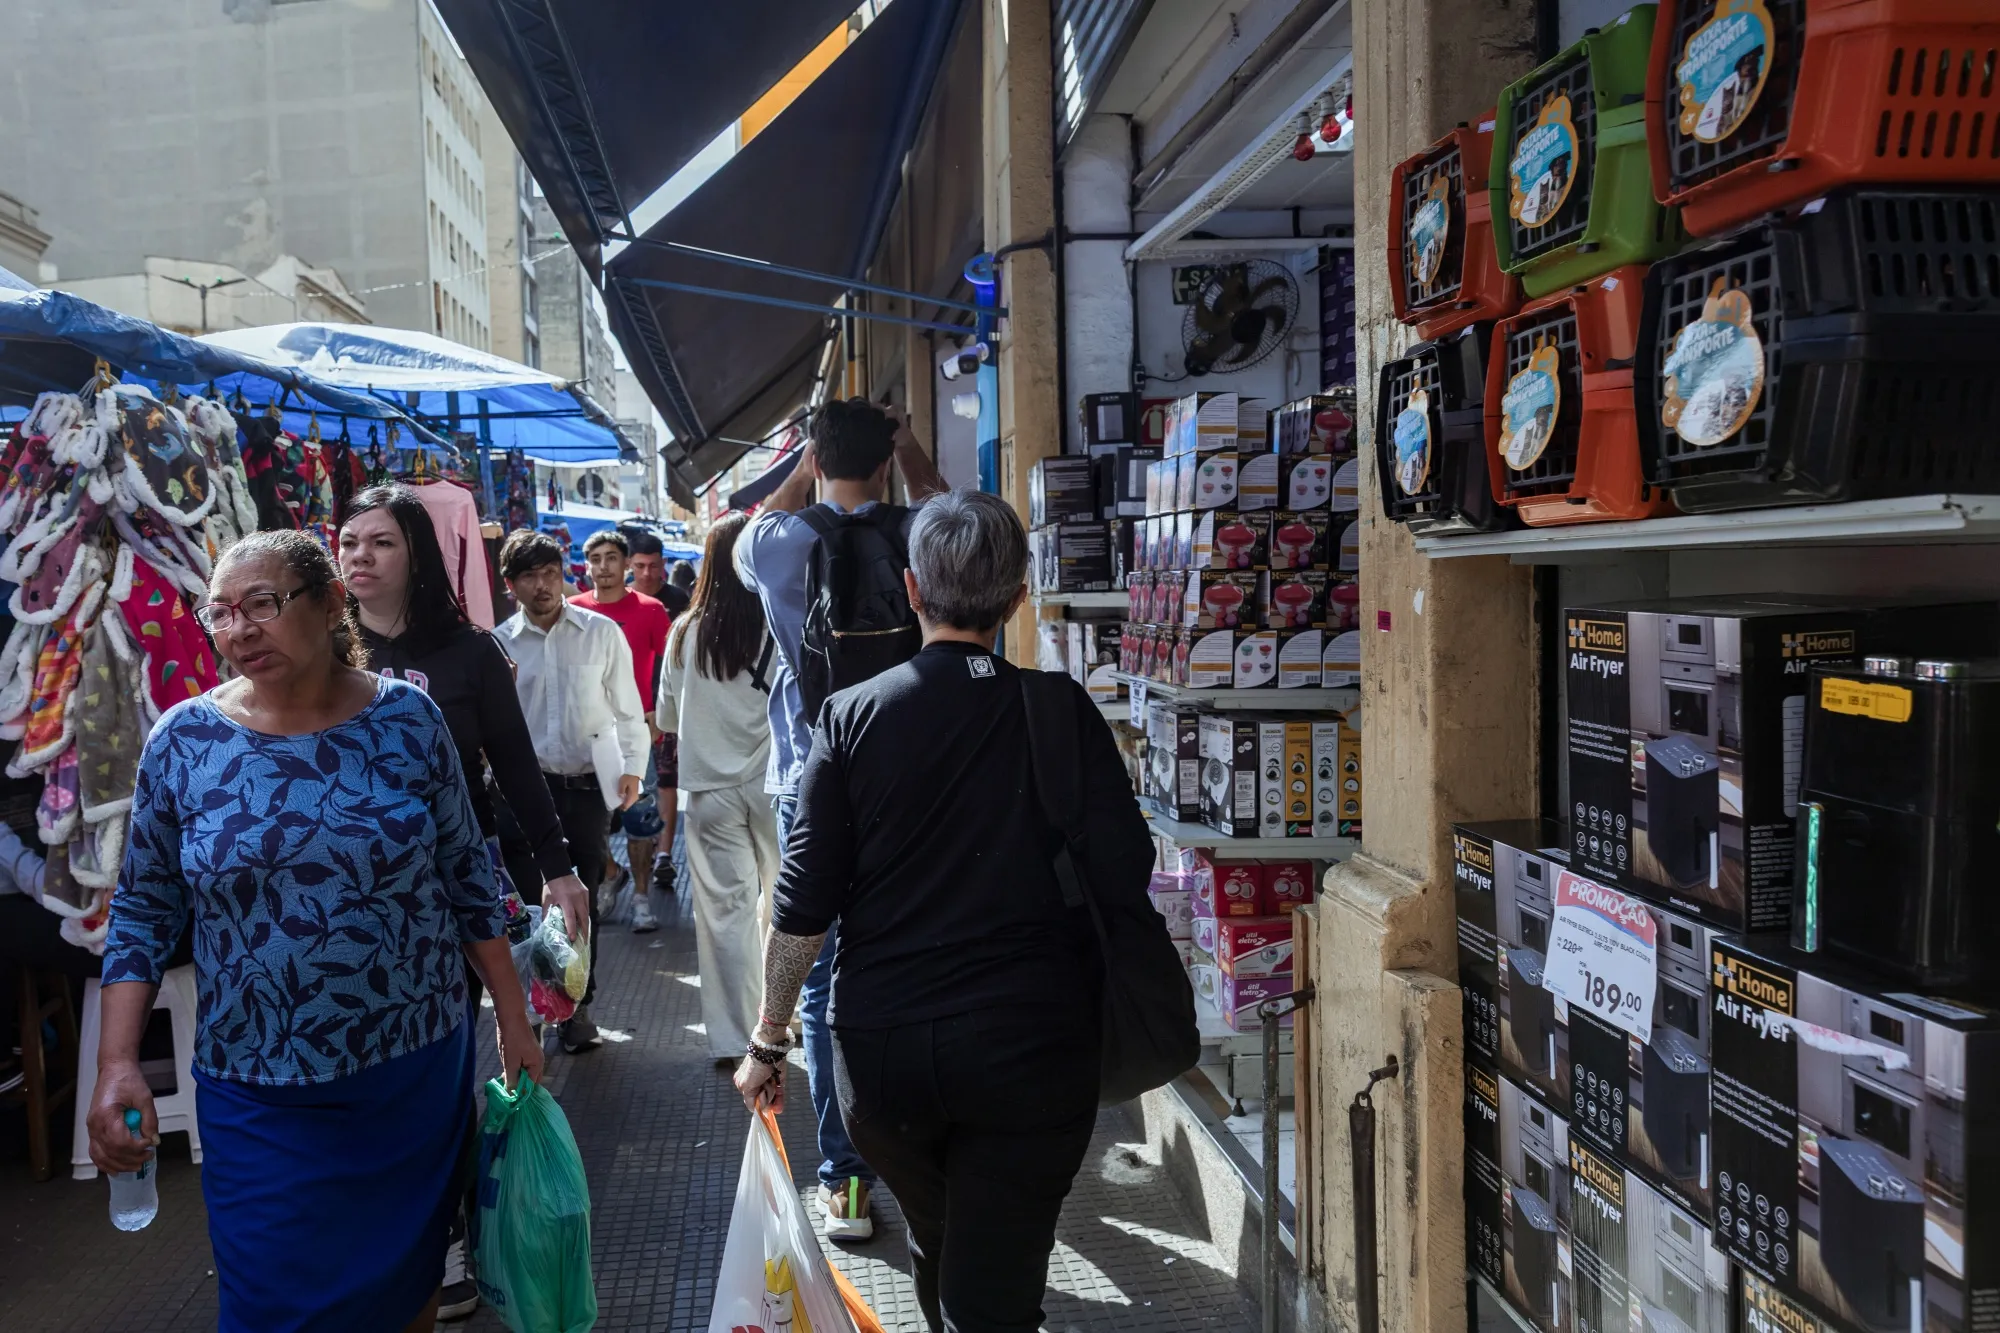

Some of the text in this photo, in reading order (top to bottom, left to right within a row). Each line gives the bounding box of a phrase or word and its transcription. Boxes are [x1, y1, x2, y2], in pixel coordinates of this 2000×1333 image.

[1678, 14, 1748, 83] TRANSPORTE
[1664, 325, 1735, 377] ANSPORTE
[1587, 625, 1622, 646] Home
[1806, 636, 1850, 651] Home
[1570, 652, 1624, 679] Air Fryer
[1784, 659, 1808, 674] Air
[1466, 844, 1490, 866] Home
[1456, 863, 1491, 890] Air Fryer
[1568, 881, 1647, 928] PROMOÇÃO
[1620, 943, 1635, 954] BLACK
[1739, 967, 1788, 1008] Home
[1715, 993, 1789, 1042] Air Fryer
[1472, 1069, 1496, 1099] Home
[1474, 1095, 1497, 1122] Fryer
[1588, 1158, 1620, 1197] Home
[1573, 1175, 1621, 1224] Air Fryer
[1748, 1307, 1770, 1333] Air
[1769, 1288, 1816, 1333] Home
